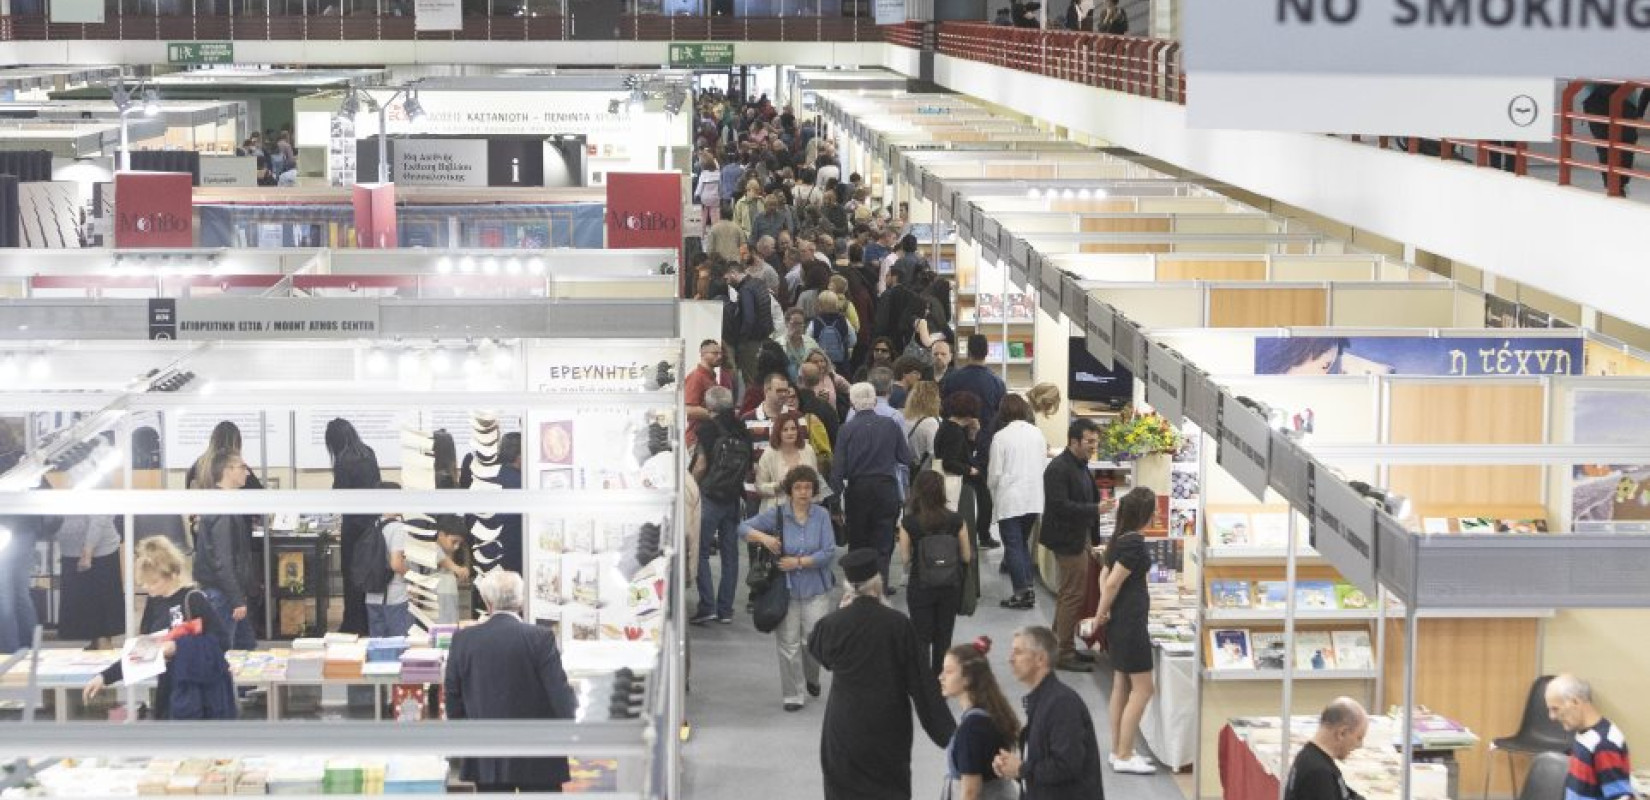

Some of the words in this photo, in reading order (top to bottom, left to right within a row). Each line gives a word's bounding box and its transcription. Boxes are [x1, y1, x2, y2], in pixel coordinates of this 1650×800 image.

[1275, 0, 1361, 27] NO
[274, 320, 305, 331] MOUNT
[309, 320, 338, 331] ATHOS
[341, 320, 374, 331] CENTER
[1478, 339, 1572, 375] τέχνη
